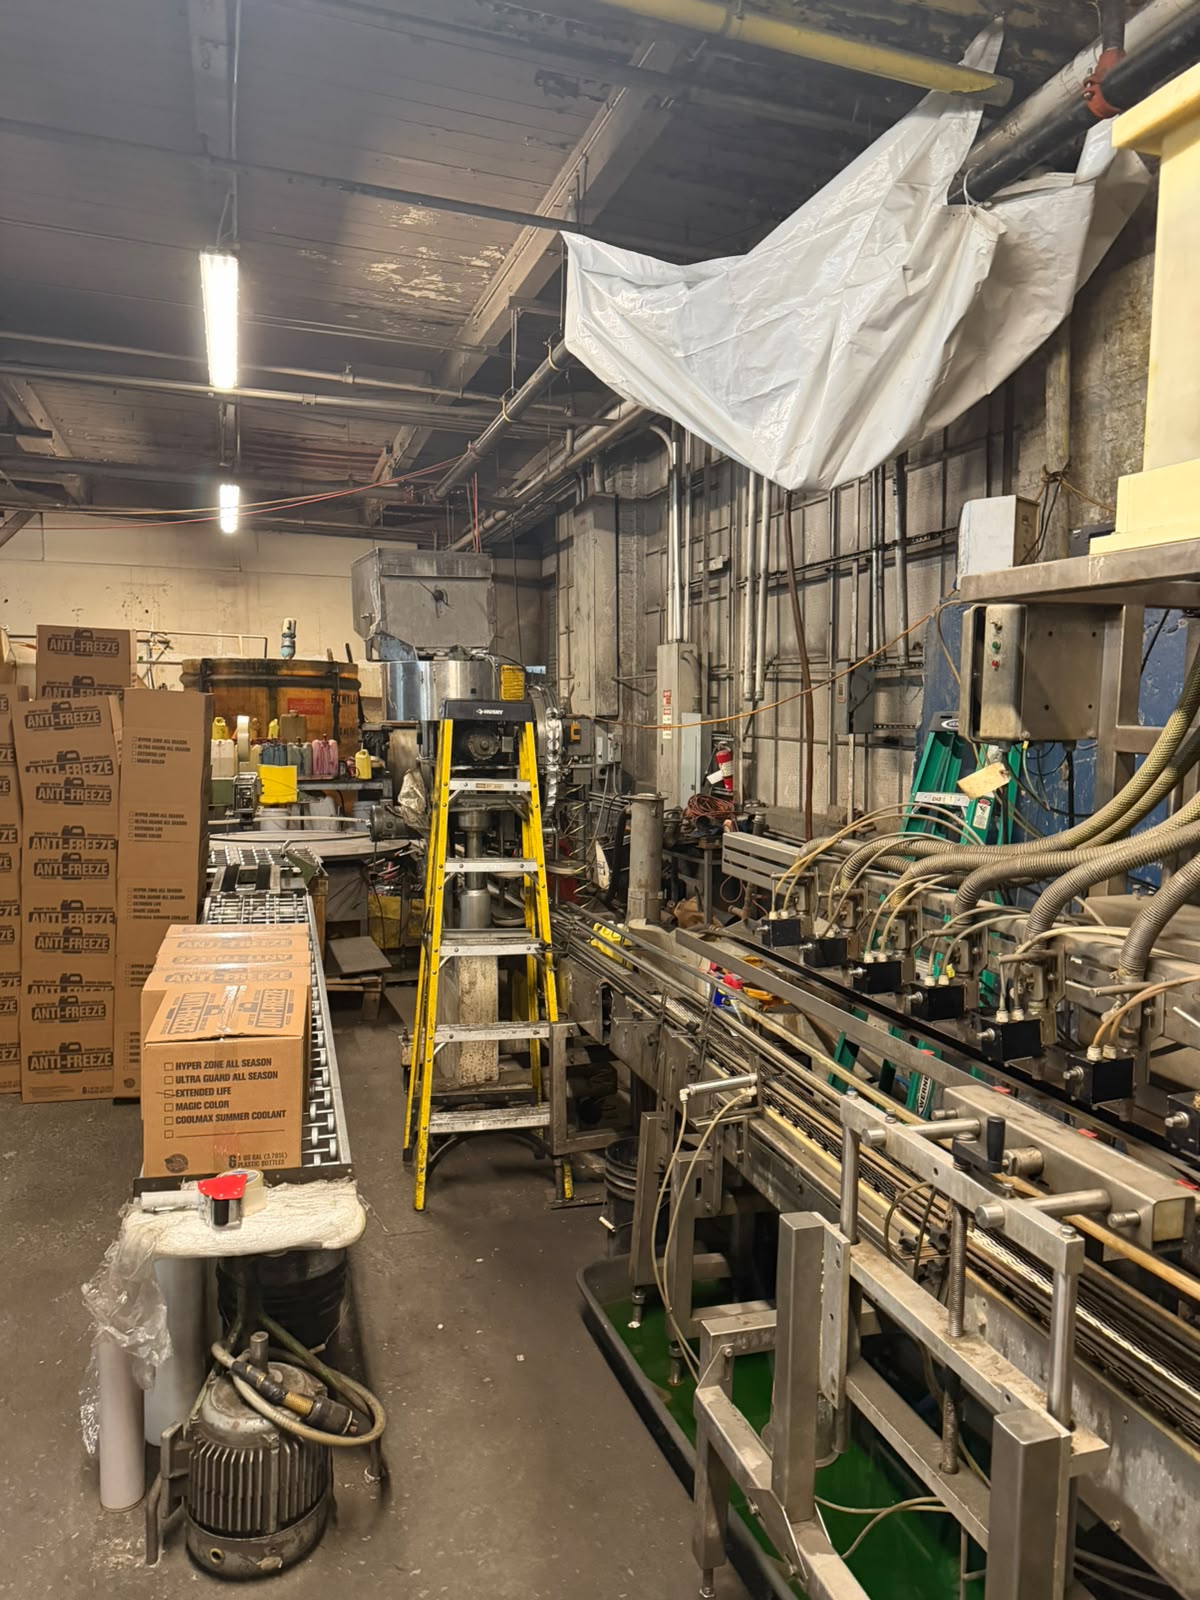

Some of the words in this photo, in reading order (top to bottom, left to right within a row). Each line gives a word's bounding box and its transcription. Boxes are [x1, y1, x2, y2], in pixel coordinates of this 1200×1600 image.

[49, 639, 119, 654] ANTI-FREEZE
[27, 710, 100, 728] ANTI-FREEZE
[37, 787, 111, 801] ANTI-FREEZE
[32, 837, 115, 850] ANTI-FREEZE
[36, 862, 108, 876] ANTI-FREEZE
[31, 912, 114, 924] ANTI-FREEZE
[36, 936, 109, 950] ANTI-FREEZE
[33, 1005, 105, 1019] ANTI-FREEZE
[30, 1052, 111, 1070] ANTI-FREEZE
[176, 1061, 202, 1071] HYPER
[204, 1060, 224, 1069] ZONE
[226, 1060, 239, 1068] ALL
[241, 1058, 272, 1067] SEASON
[176, 1075, 201, 1084] ULTRA
[203, 1073, 230, 1082] GUARD
[232, 1072, 246, 1081] ALL
[248, 1071, 278, 1080] SEASON
[176, 1088, 214, 1097] EXTENDED
[216, 1087, 232, 1095] LIFE
[918, 1076, 929, 1108] WERNE
[176, 1102, 202, 1111] MAGIC
[204, 1100, 229, 1109] COLOR
[176, 1114, 214, 1124] COOLMAX
[215, 1112, 249, 1122] SUMMER
[252, 1110, 287, 1120] COOLANT
[229, 1154, 236, 1168] 6
